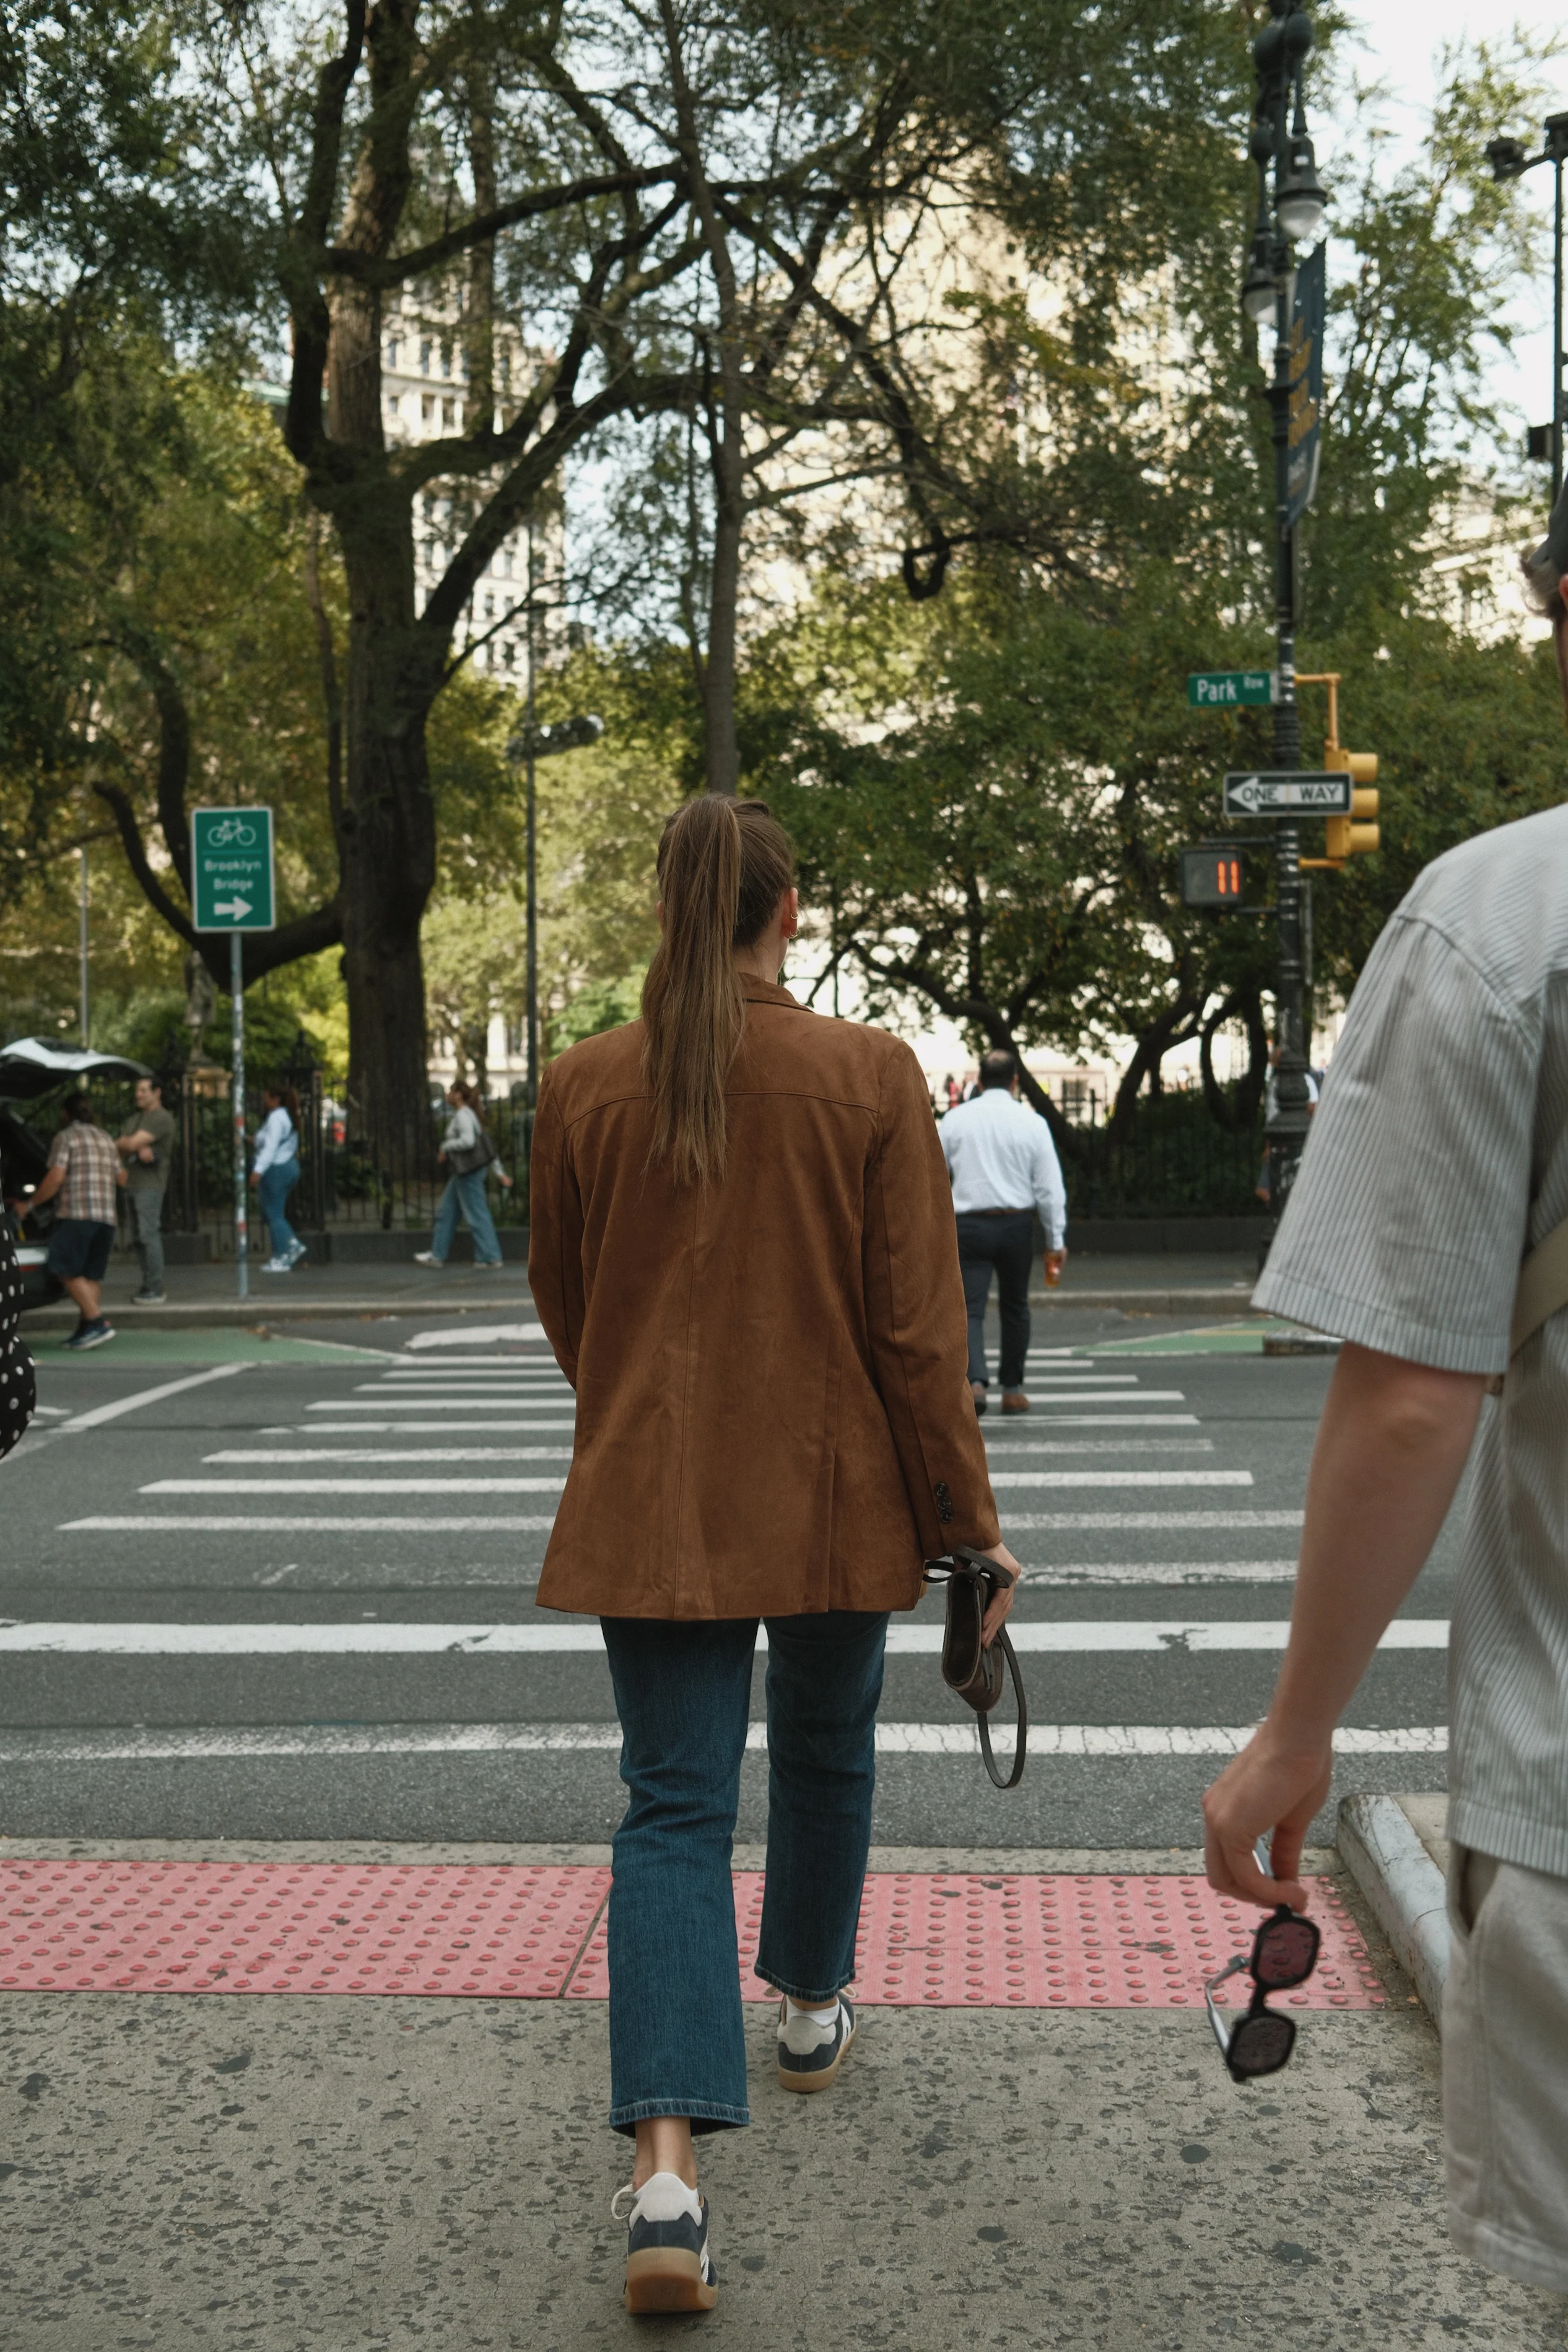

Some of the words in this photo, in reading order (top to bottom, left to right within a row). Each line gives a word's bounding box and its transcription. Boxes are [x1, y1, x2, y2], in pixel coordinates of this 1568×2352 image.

[1197, 678, 1237, 702] Park
[1242, 786, 1278, 803] ONE
[1301, 786, 1338, 802] WAY
[204, 860, 261, 873] Brooklyn
[213, 878, 253, 892] Bridge
[1217, 860, 1239, 895] 11
